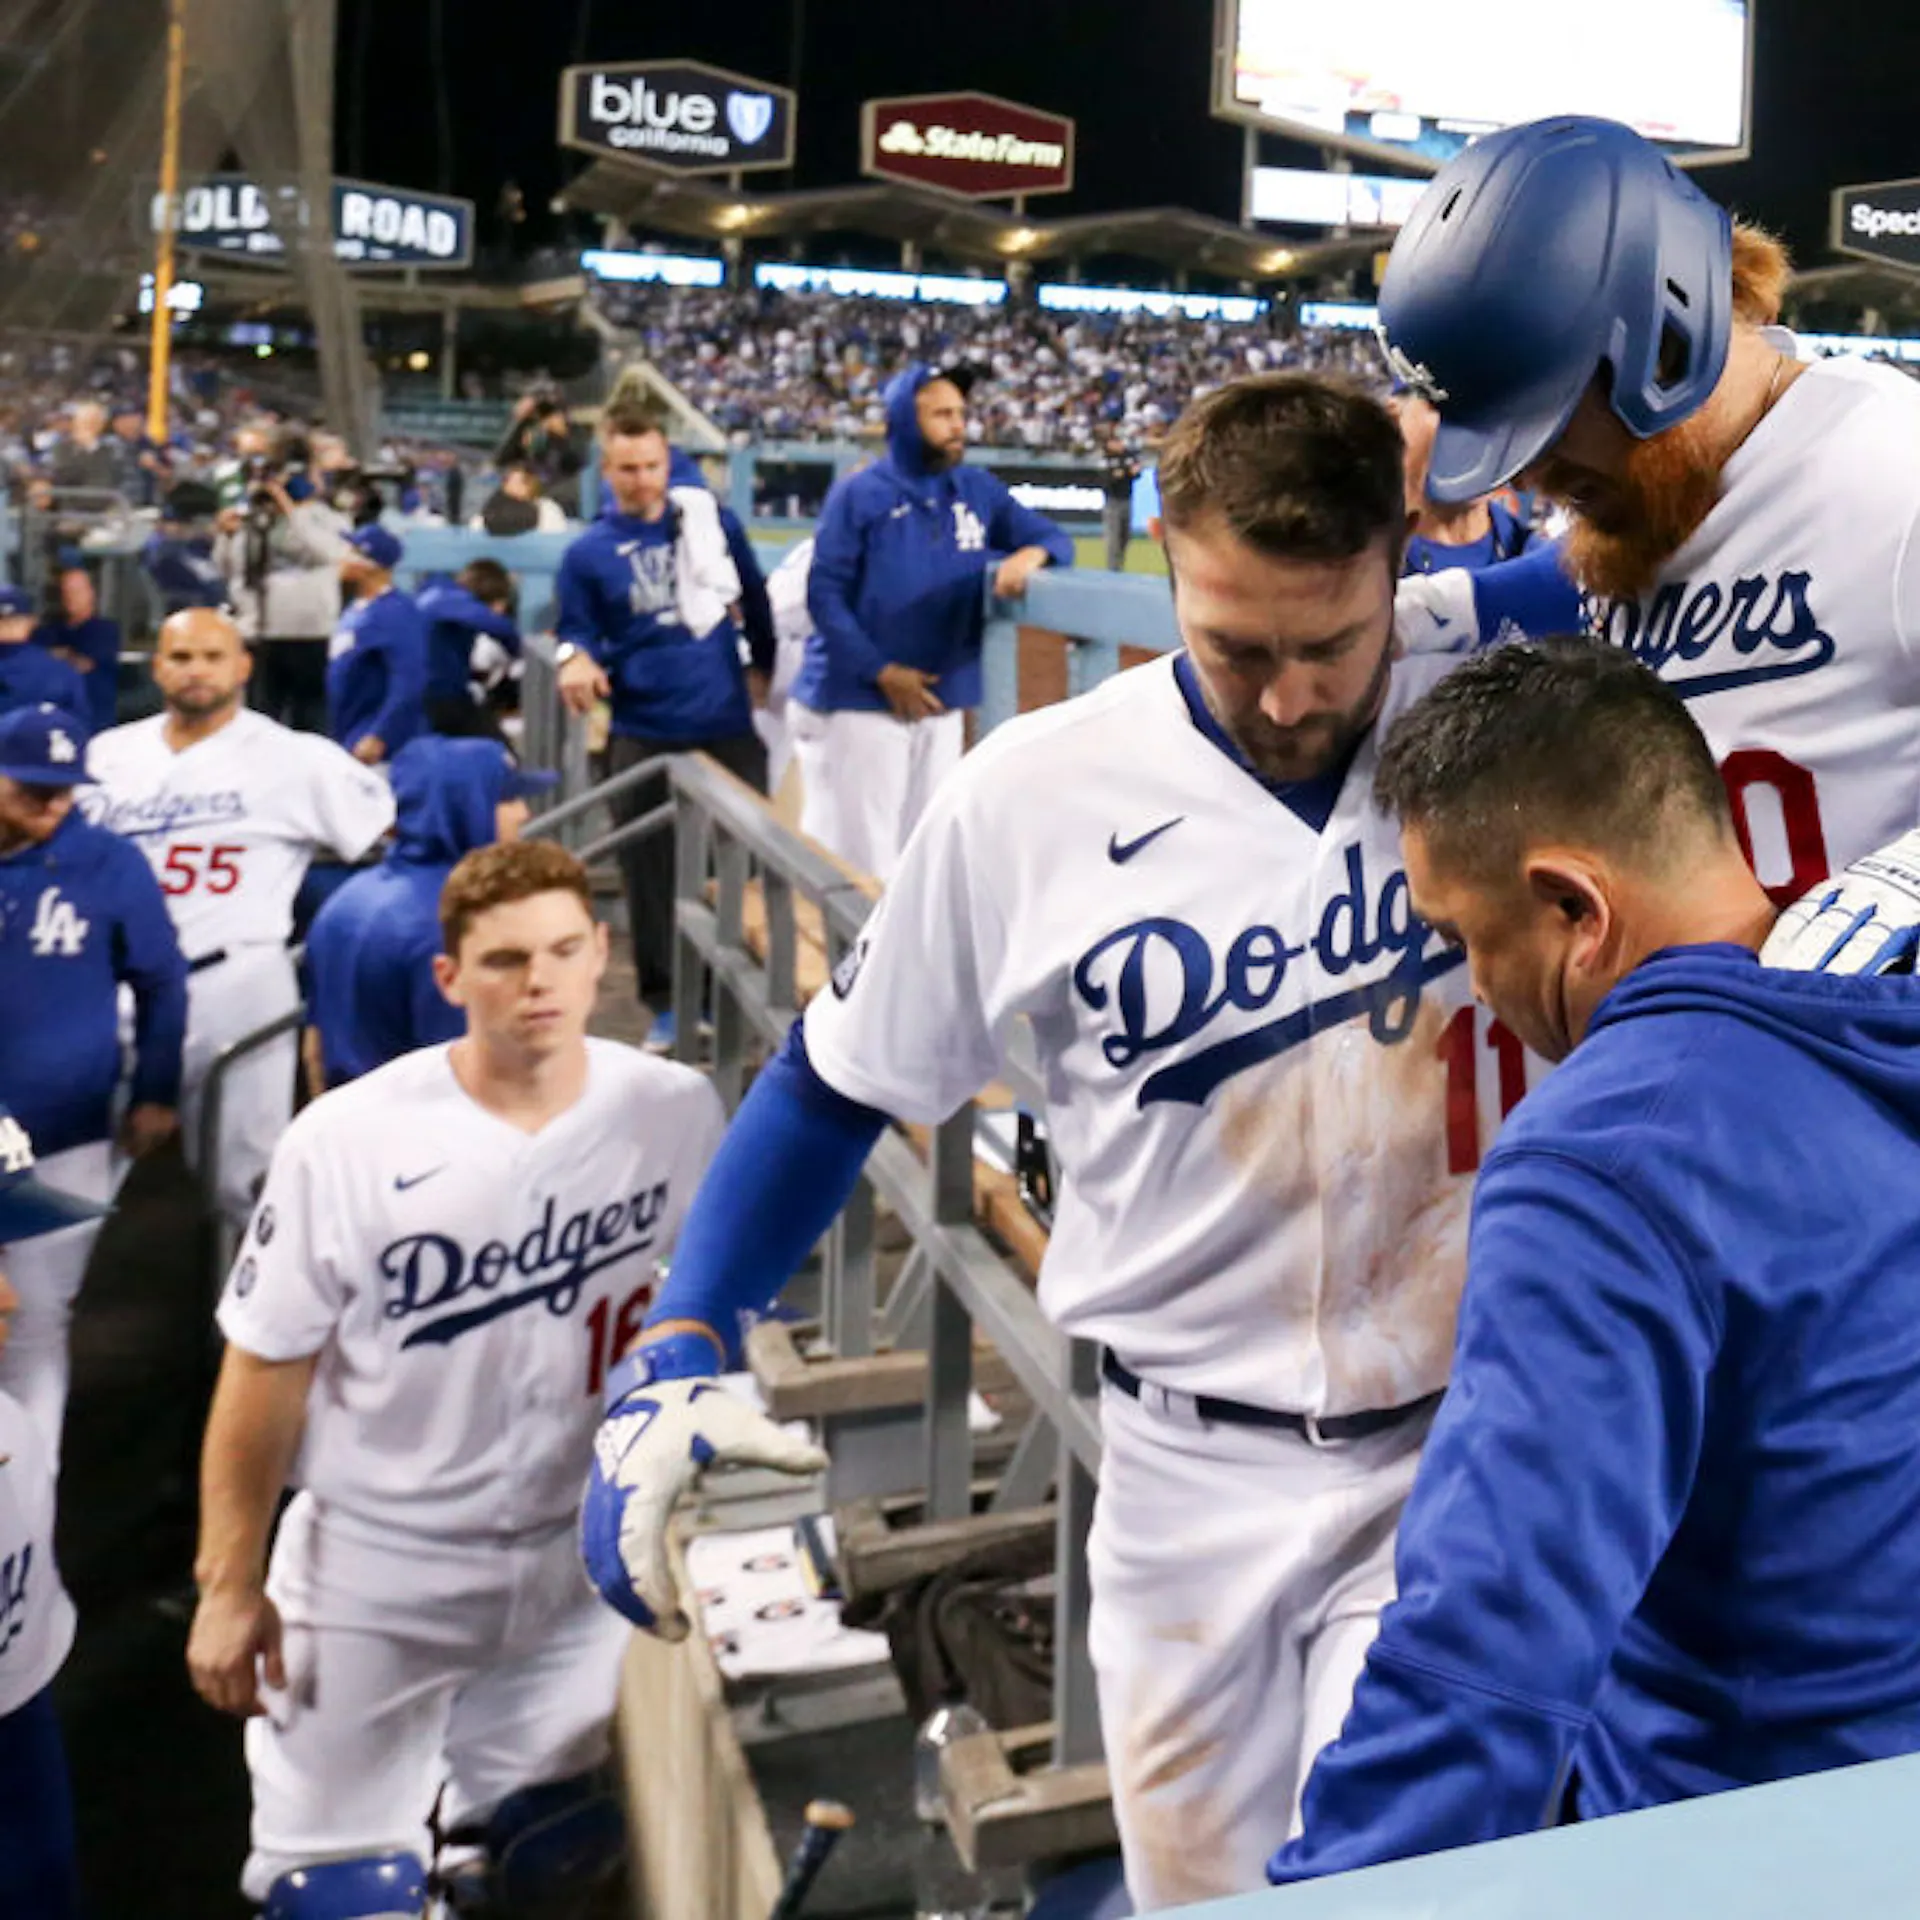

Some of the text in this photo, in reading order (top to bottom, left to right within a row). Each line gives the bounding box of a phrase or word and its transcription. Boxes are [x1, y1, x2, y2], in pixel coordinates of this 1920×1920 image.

[590, 73, 718, 132] blue
[151, 184, 309, 233] GOLD
[340, 192, 457, 257] ROAD
[1851, 203, 1920, 238] Spec
[952, 502, 986, 551] LA
[158, 844, 247, 896] 55
[29, 886, 90, 956] LA
[1436, 1004, 1527, 1177] 11
